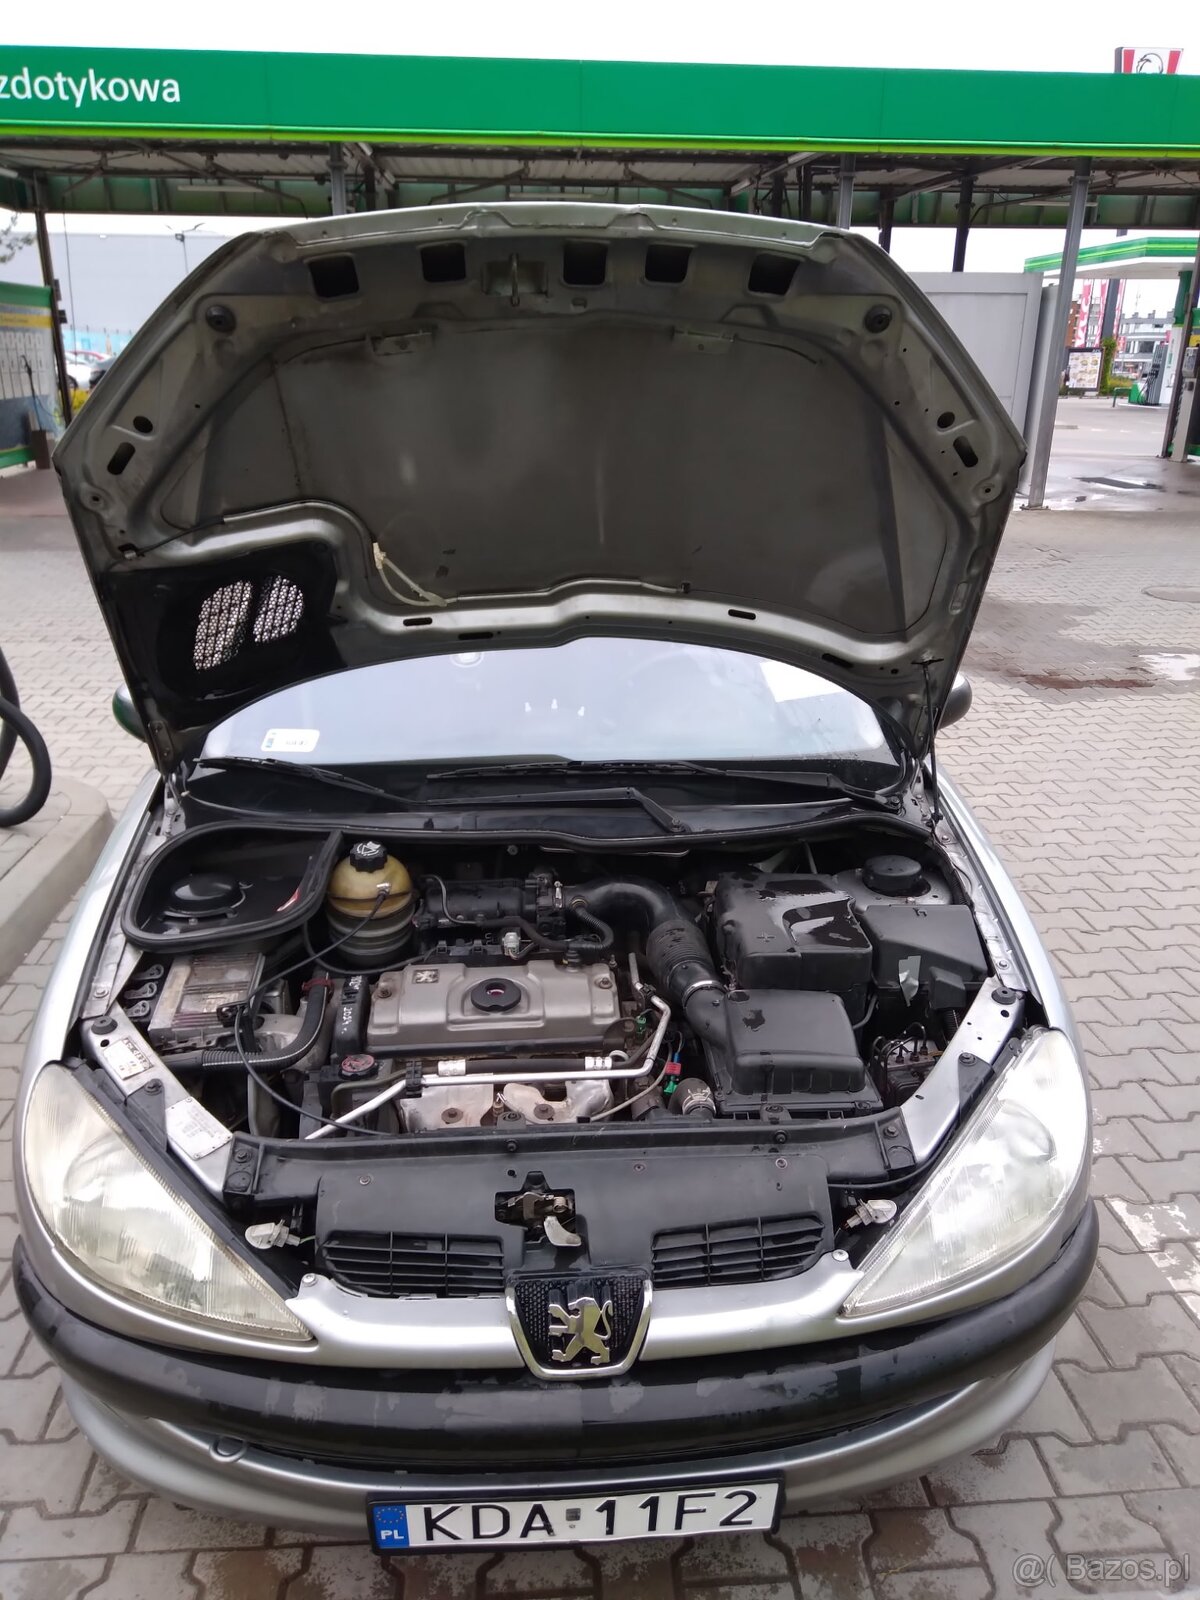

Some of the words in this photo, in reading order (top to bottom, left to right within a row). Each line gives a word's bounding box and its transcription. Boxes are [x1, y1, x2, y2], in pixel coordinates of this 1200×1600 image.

[423, 1504, 555, 1541] KDA
[595, 1490, 758, 1535] 11F2
[380, 1528, 404, 1541] PL
